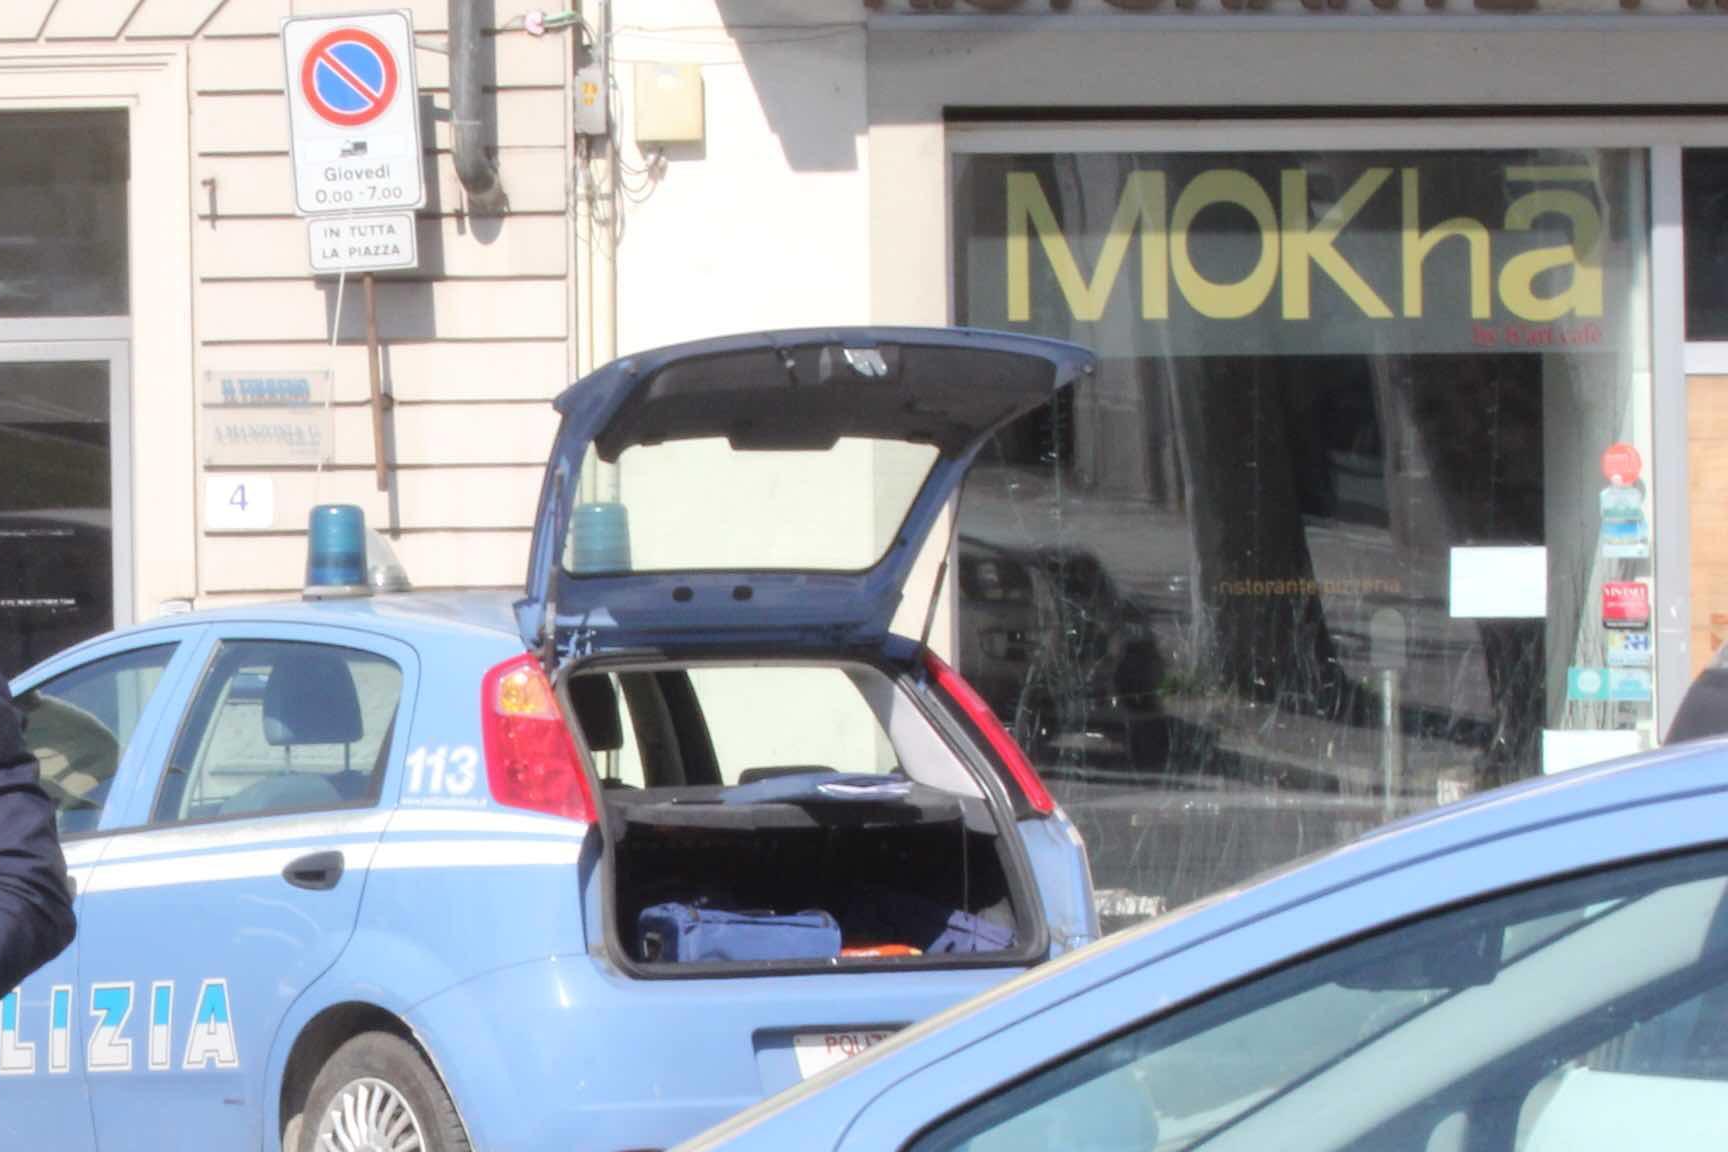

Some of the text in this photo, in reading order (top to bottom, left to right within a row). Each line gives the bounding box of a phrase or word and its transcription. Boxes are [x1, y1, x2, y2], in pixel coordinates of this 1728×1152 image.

[323, 224, 396, 238] IN TUTTA
[322, 243, 401, 259] LA PIAZZA
[229, 483, 248, 511] 4
[406, 746, 478, 795] 113
